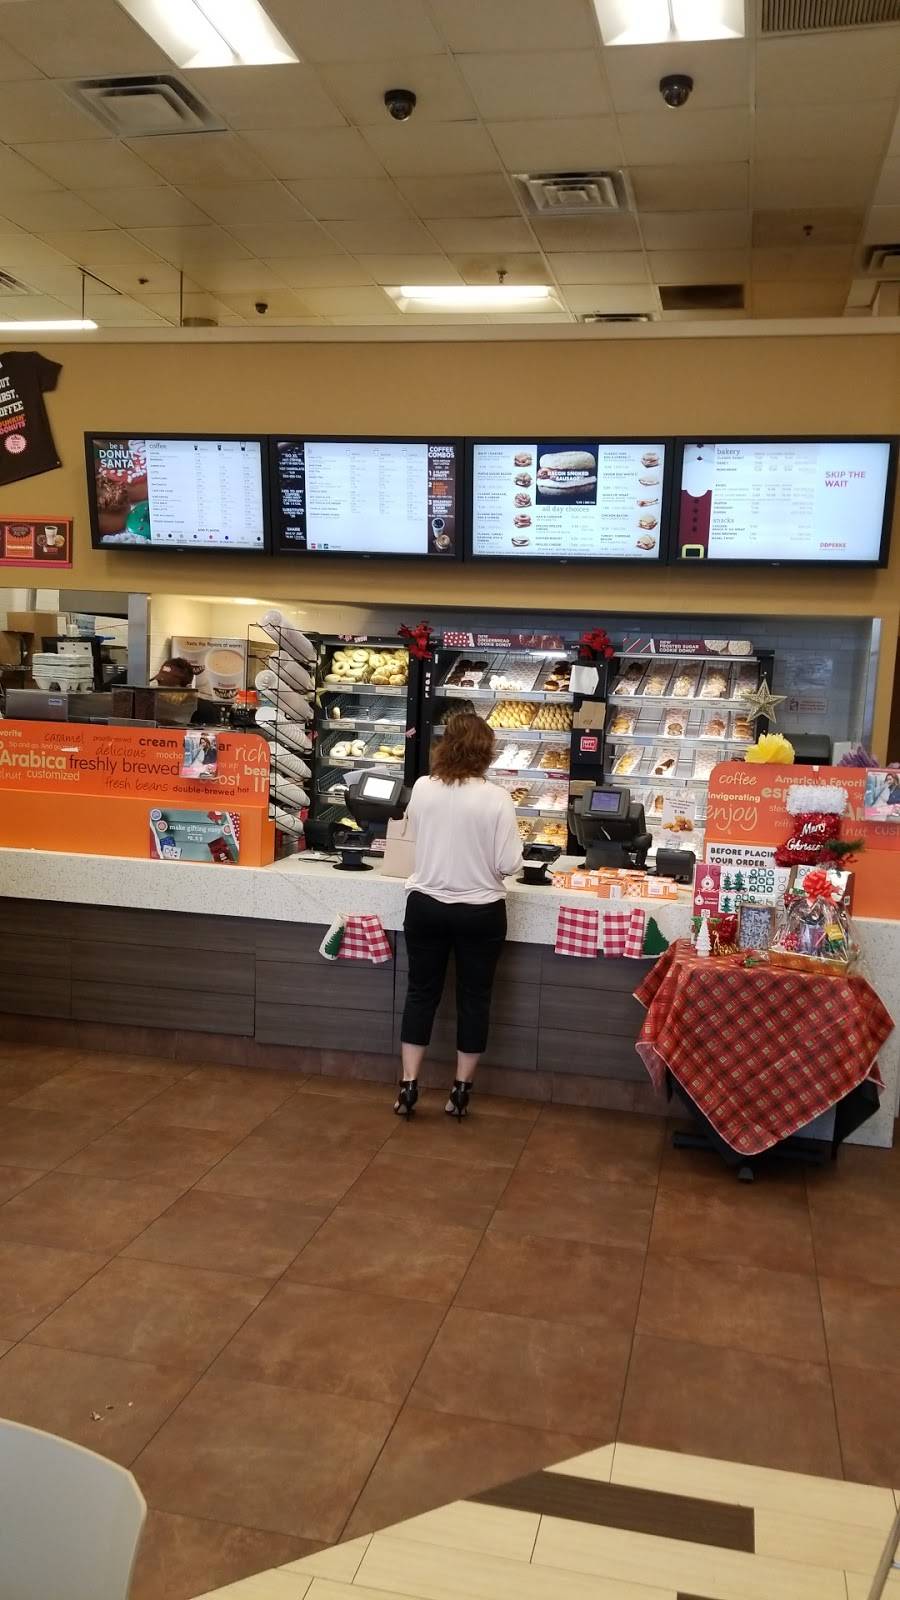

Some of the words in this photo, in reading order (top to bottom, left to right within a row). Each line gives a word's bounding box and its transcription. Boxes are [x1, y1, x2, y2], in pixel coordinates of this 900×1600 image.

[0, 401, 24, 417] OFFEE
[99, 450, 134, 459] DONUT
[716, 447, 741, 456] bakery
[100, 459, 135, 469] SANTA
[825, 480, 848, 488] WAIT
[552, 505, 564, 514] day
[565, 505, 590, 513] choices
[0, 729, 22, 738] vorite
[139, 737, 178, 748] cream
[96, 743, 147, 757] delicious
[235, 743, 267, 763] rich
[0, 749, 66, 769] Arabica
[69, 754, 117, 775] freshly
[122, 757, 181, 776] brewed
[27, 769, 80, 781] customized
[244, 764, 268, 777] bea
[105, 776, 131, 789] fresh
[135, 779, 168, 792] beans
[718, 771, 759, 785] coffee
[172, 785, 235, 797] double-brewed
[708, 792, 761, 804] invigorating
[706, 803, 758, 832] enjoy
[800, 821, 827, 838] Merry
[710, 847, 742, 857] BEFORE
[744, 849, 775, 858] PLACIN
[710, 856, 734, 865] YOUR
[735, 858, 768, 867] ORDER.
